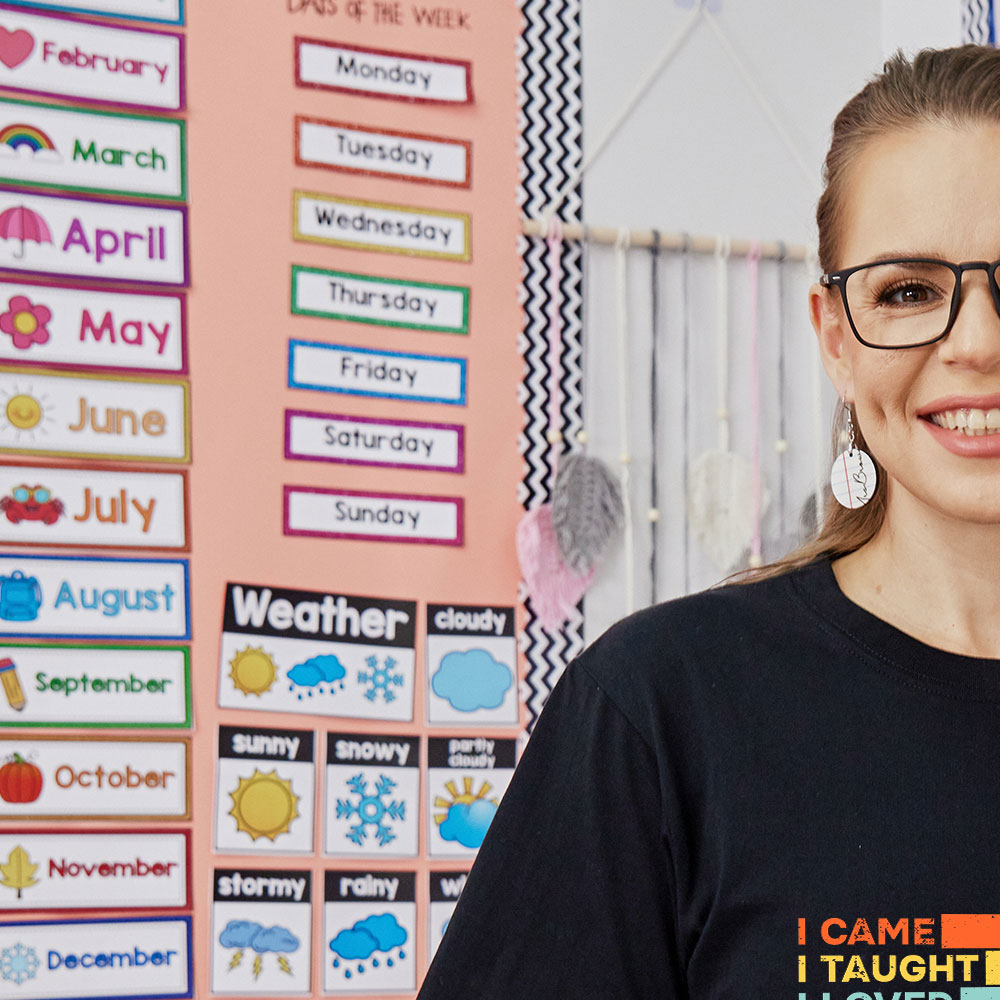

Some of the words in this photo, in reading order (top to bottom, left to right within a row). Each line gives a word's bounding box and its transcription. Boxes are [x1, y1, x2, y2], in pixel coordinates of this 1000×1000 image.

[373, 3, 402, 26] THE
[413, 6, 472, 29] WEEK
[43, 41, 168, 83] February
[335, 55, 432, 90] Monday
[73, 139, 165, 170] March
[336, 133, 434, 170] Tuesday
[62, 218, 165, 263] April
[315, 206, 452, 246] Wednesday
[328, 282, 439, 317] Thursday
[80, 309, 170, 355] May
[340, 356, 418, 387] Friday
[69, 397, 166, 436] June
[324, 425, 435, 457] Saturday
[74, 488, 155, 533] July
[335, 502, 421, 529] Sunday
[54, 581, 174, 619] August
[233, 586, 409, 642] Weather
[433, 607, 507, 636] cloudy
[36, 672, 173, 697] September
[232, 733, 300, 759] sunny
[335, 738, 410, 766] snowy
[448, 738, 495, 756] partly
[448, 751, 496, 769] cloudy
[55, 765, 174, 788] October
[49, 858, 176, 877] November
[219, 873, 305, 901] stormy
[339, 874, 400, 902] rainy
[798, 918, 805, 945] I
[821, 918, 934, 945] CAME
[48, 947, 176, 970] December
[799, 956, 806, 982] I
[820, 955, 979, 982] TAUGHT
